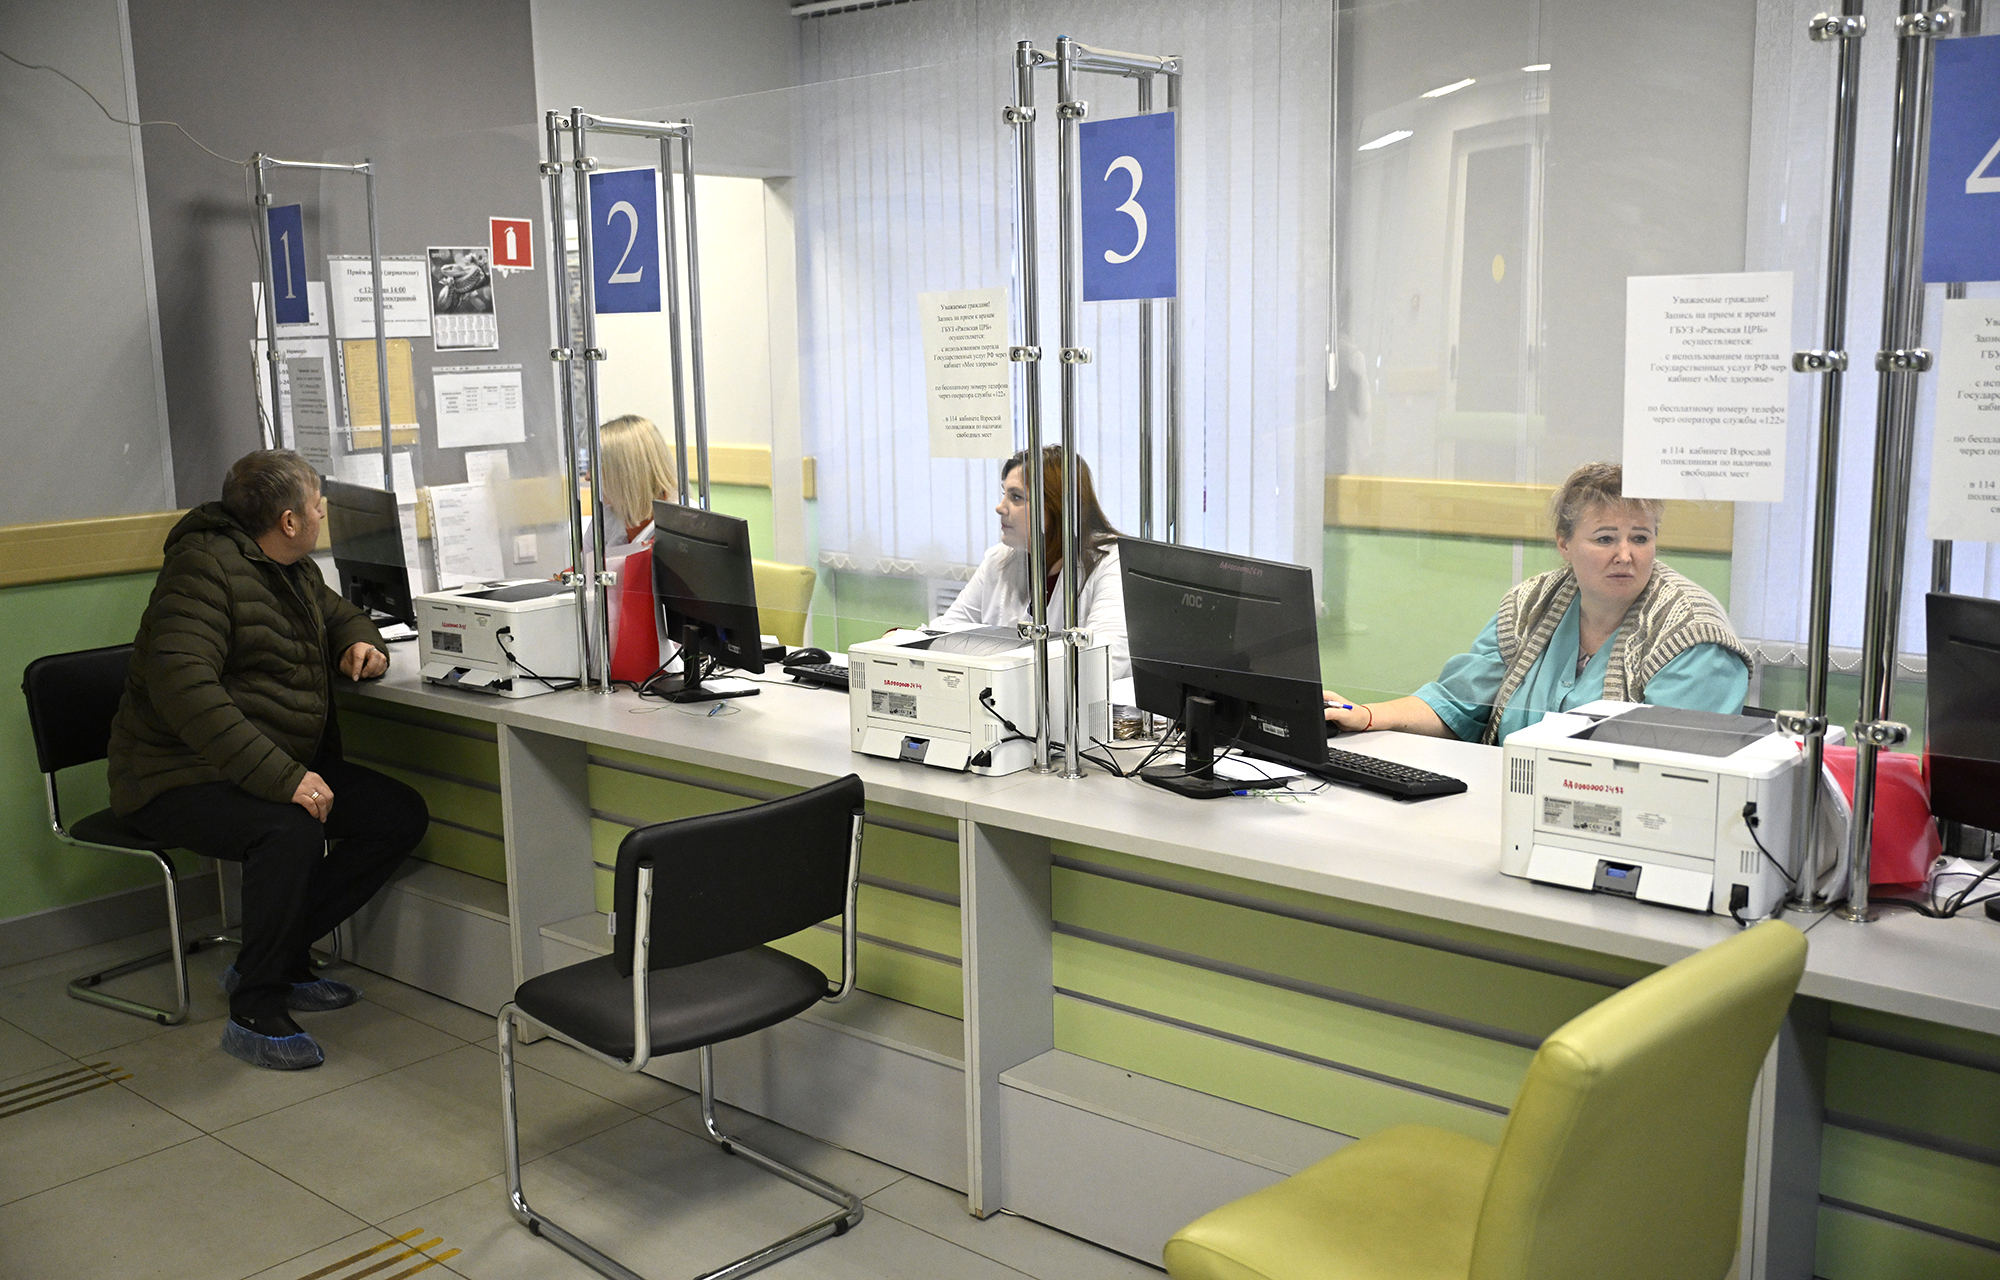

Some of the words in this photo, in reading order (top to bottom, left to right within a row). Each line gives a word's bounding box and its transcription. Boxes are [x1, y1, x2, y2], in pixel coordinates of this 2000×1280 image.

[1104, 155, 1147, 264] 3
[607, 201, 643, 284] 2
[281, 231, 296, 298] 1
[1672, 296, 1721, 304] Уважаемые
[1725, 295, 1769, 304] граждане!
[1708, 312, 1734, 320] прием
[1745, 311, 1775, 319] врачам
[1669, 326, 1693, 334] ГБУЗ
[1696, 326, 1741, 334] «Ржевская
[1743, 325, 1768, 334] ЦРБ»
[1682, 338, 1752, 347] осуществляется:
[1744, 353, 1779, 362] портала
[1650, 363, 1724, 373] Государственных
[1727, 364, 1751, 373] услуг
[1754, 363, 1768, 371] РФ
[1771, 365, 1787, 373] чер
[1668, 374, 1701, 383] кабинет
[1704, 375, 1727, 383] «Мое
[1731, 375, 1773, 384] здоровье»
[1660, 404, 1714, 414] бесплатному
[1716, 405, 1748, 414] номеру
[1653, 417, 1675, 425] через
[1677, 417, 1720, 425] оператора
[1723, 416, 1756, 426] службы
[1689, 447, 1727, 455] кабинете
[1730, 447, 1771, 456] Взрослой
[1661, 458, 1717, 466] поликлиники
[1680, 468, 1727, 477] свободных
[1181, 593, 1203, 609] AOC
